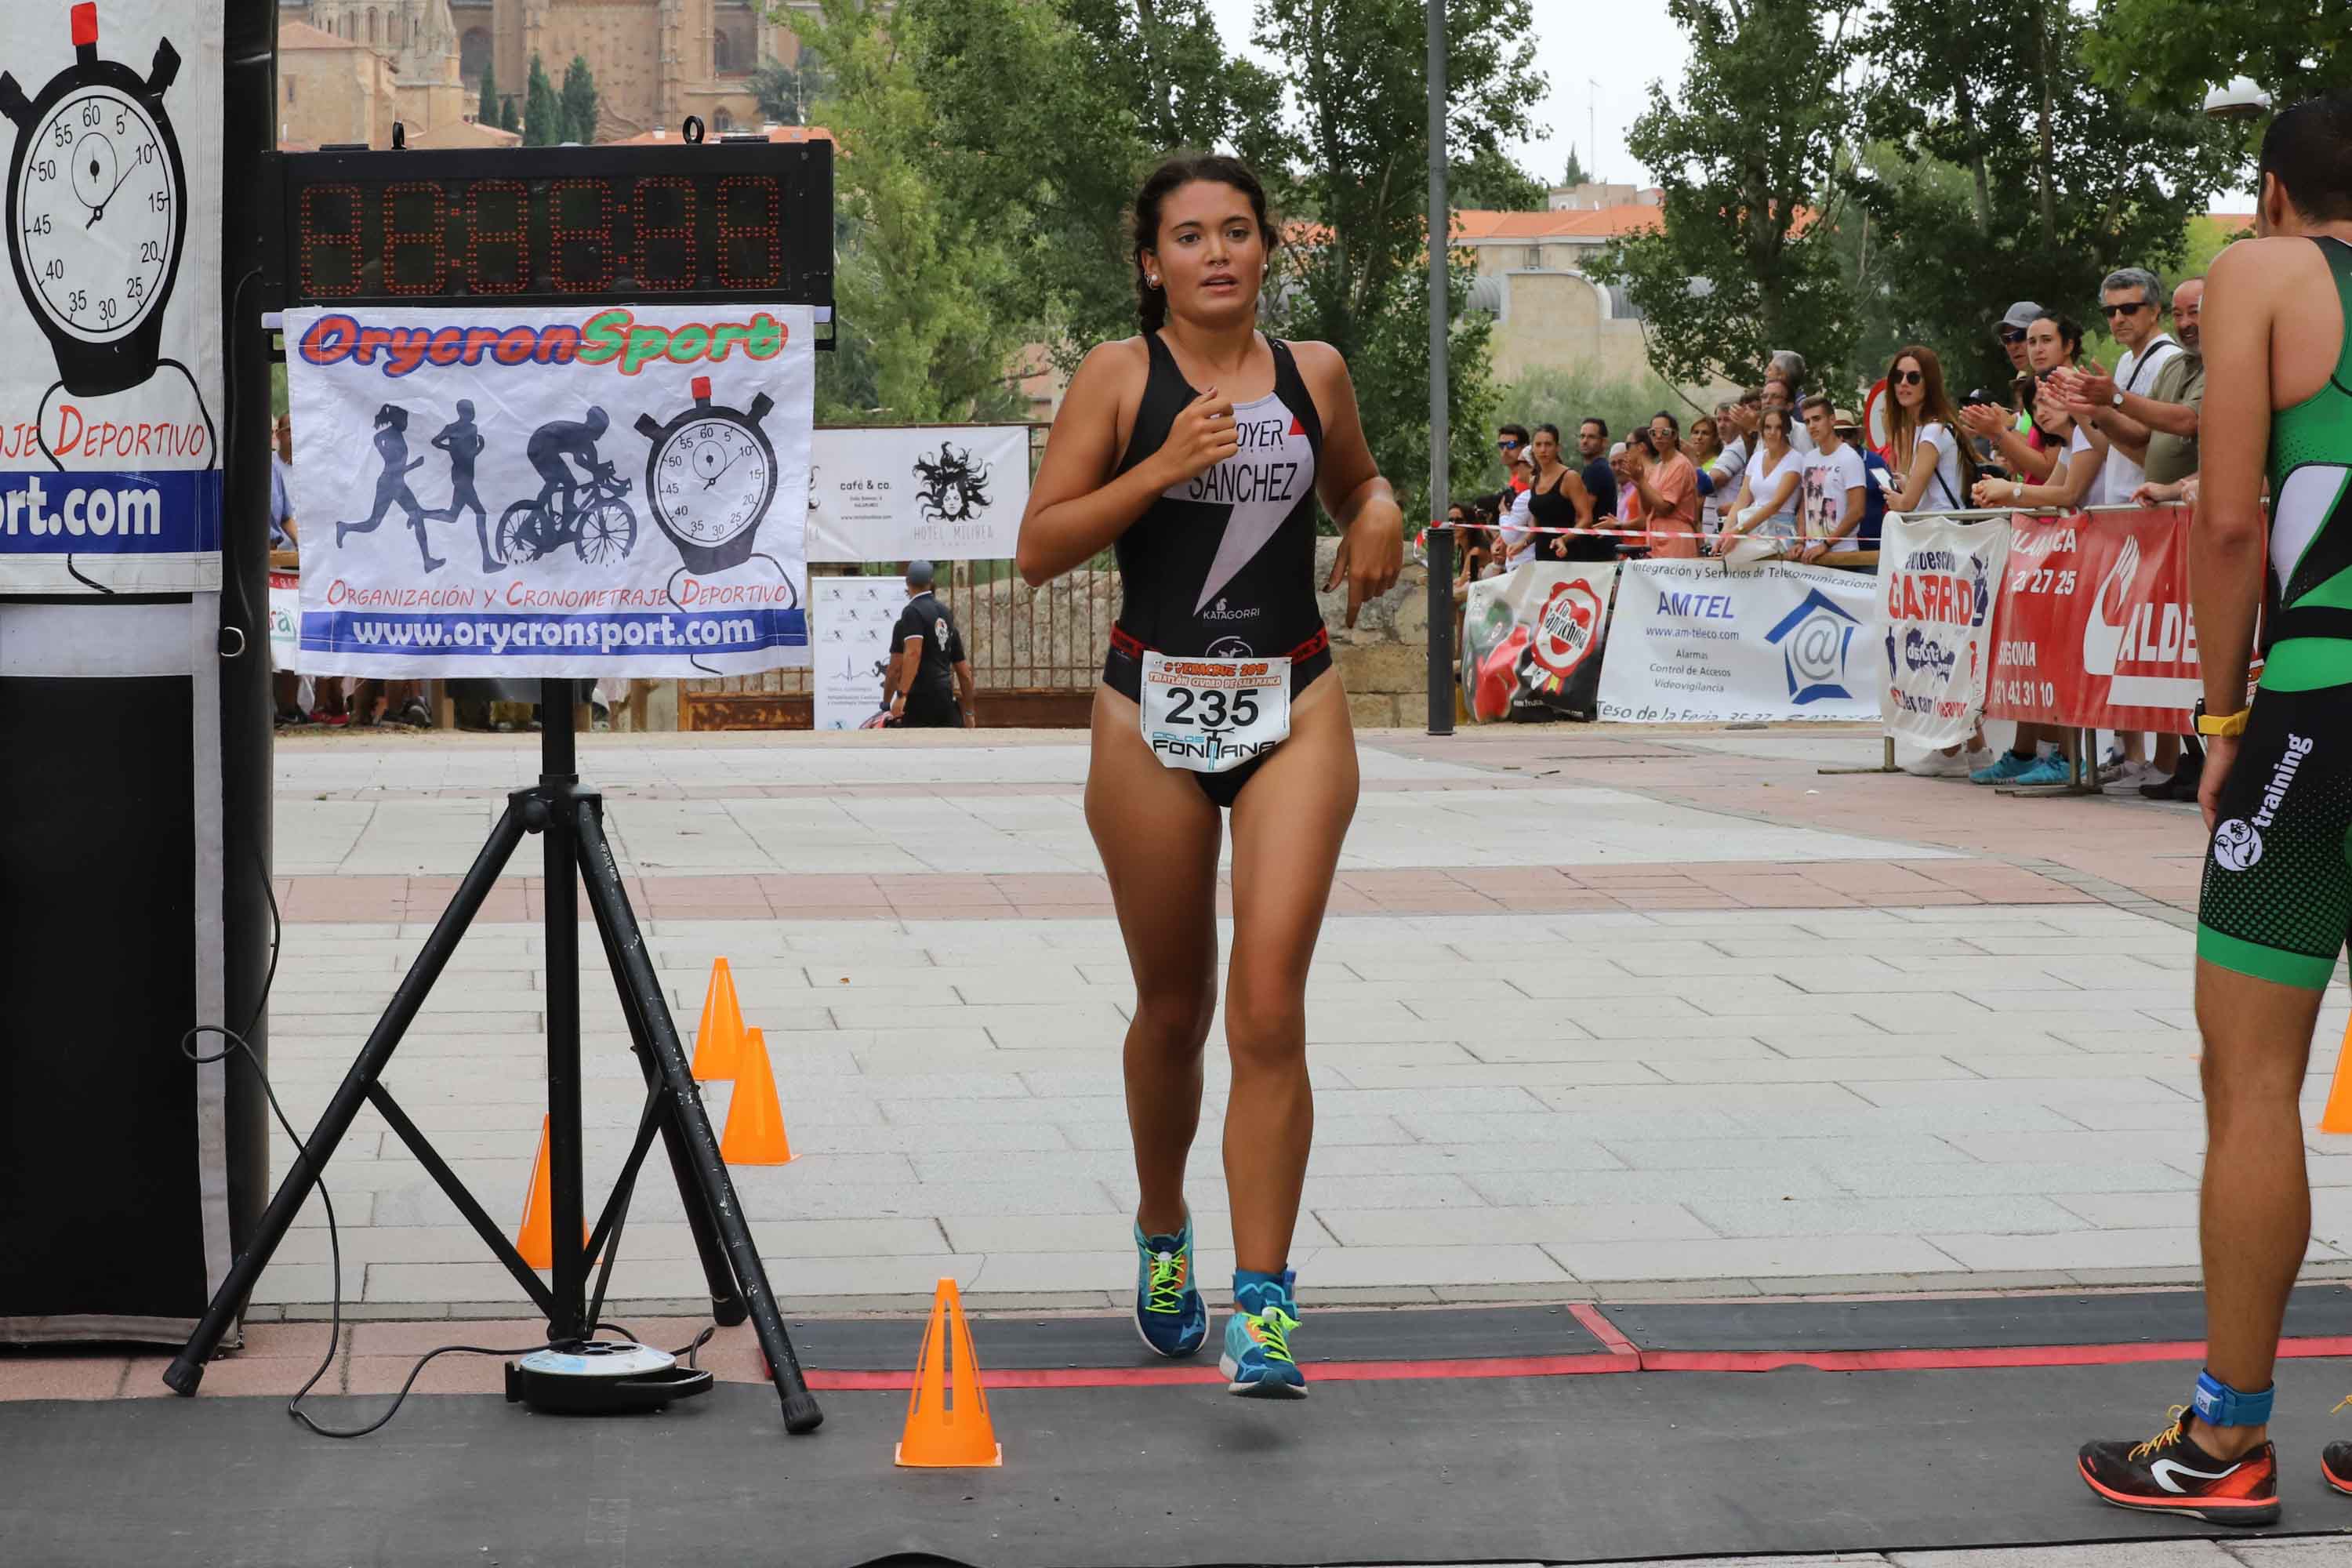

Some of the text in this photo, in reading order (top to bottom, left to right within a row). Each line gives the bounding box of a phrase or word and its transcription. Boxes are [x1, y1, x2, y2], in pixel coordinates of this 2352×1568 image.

[83, 105, 100, 127] 60
[116, 114, 125, 135] 5
[55, 124, 73, 147] 55
[136, 143, 152, 165] 10
[38, 159, 56, 182] 50
[148, 191, 165, 212] 15
[33, 214, 51, 236] 45
[141, 241, 158, 263] 20
[45, 259, 64, 280] 40
[127, 277, 143, 298] 25
[69, 290, 87, 312] 35
[99, 298, 116, 321] 30
[299, 309, 788, 378] OrycronSport
[53, 405, 205, 458] DEPORTIVO
[700, 427, 713, 439] 60
[724, 432, 731, 442] 5
[1236, 419, 1283, 448] OYER
[680, 438, 694, 450] 55
[739, 445, 752, 457] 10
[669, 456, 682, 467] 50
[750, 470, 760, 480] 15
[666, 483, 679, 495] 45
[675, 505, 688, 516] 40
[743, 494, 753, 506] 20
[691, 521, 704, 533] 35
[731, 512, 742, 524] 25
[713, 524, 724, 536] 30
[1633, 561, 1691, 578] Integración
[1695, 568, 1701, 579] y
[1753, 567, 1764, 578] de
[2031, 568, 2054, 593] 27
[2054, 569, 2078, 595] 25
[328, 579, 474, 607] ORGANIZACIÓN
[506, 581, 667, 608] CRONOMETRAJE
[679, 579, 787, 605] DEPORTIVO
[1203, 608, 1260, 620] KATAGORRI
[1657, 591, 1734, 619] AMTEL
[353, 615, 755, 653] www.orycronsport.com
[1646, 627, 1739, 641] www.am-teleco.com
[1676, 648, 1708, 659] Alarmas
[1650, 663, 1731, 677] Control de Accesos
[1223, 678, 1236, 688] DE
[1655, 678, 1724, 692] Videovigilancia
[2023, 680, 2035, 707] 31
[2039, 681, 2054, 708] 10
[1165, 687, 1258, 727] 235
[1596, 701, 1632, 720] Teso
[2251, 733, 2314, 828] training
